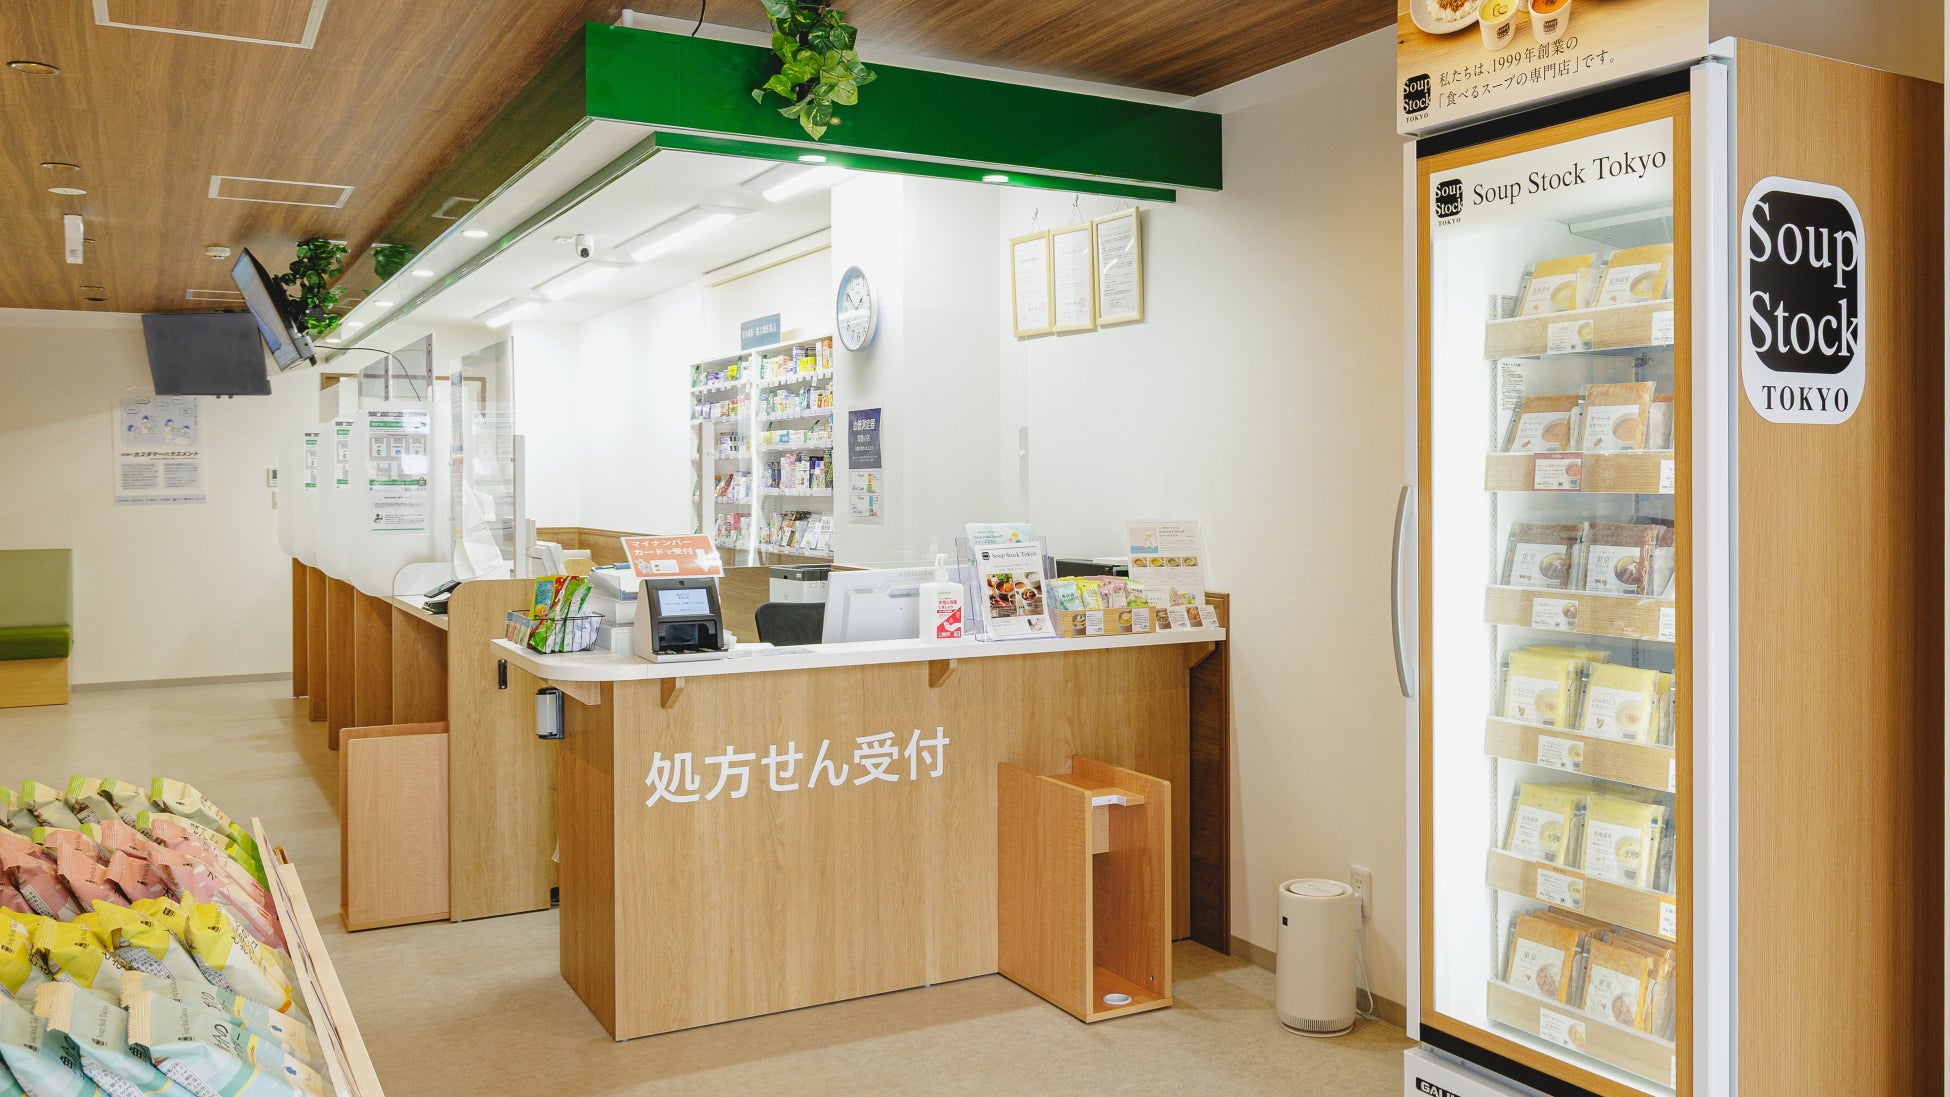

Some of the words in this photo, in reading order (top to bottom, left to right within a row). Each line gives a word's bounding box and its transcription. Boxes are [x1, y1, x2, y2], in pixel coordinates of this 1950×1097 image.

[1439, 36, 1579, 88] 私たちは、1999年創業の
[1403, 75, 1431, 95] Soup
[1438, 50, 1615, 109] 「食べるスープの専門店」です。
[1403, 94, 1431, 114] Stock
[1405, 113, 1429, 123] TOKYO
[1473, 181, 1521, 206] Soup
[1528, 162, 1586, 195] Stock
[1592, 151, 1667, 182] Tokyo
[1435, 180, 1463, 199] Soup
[1435, 198, 1463, 217] Stock
[1438, 217, 1461, 227] TOKYO
[1750, 200, 1858, 289] Soup
[1750, 290, 1859, 356] Stock
[1762, 385, 1849, 412] TOKYO
[630, 539, 692, 547] マイナンバー
[633, 547, 694, 556] カードで受付
[644, 726, 950, 808] 処方せん受付
